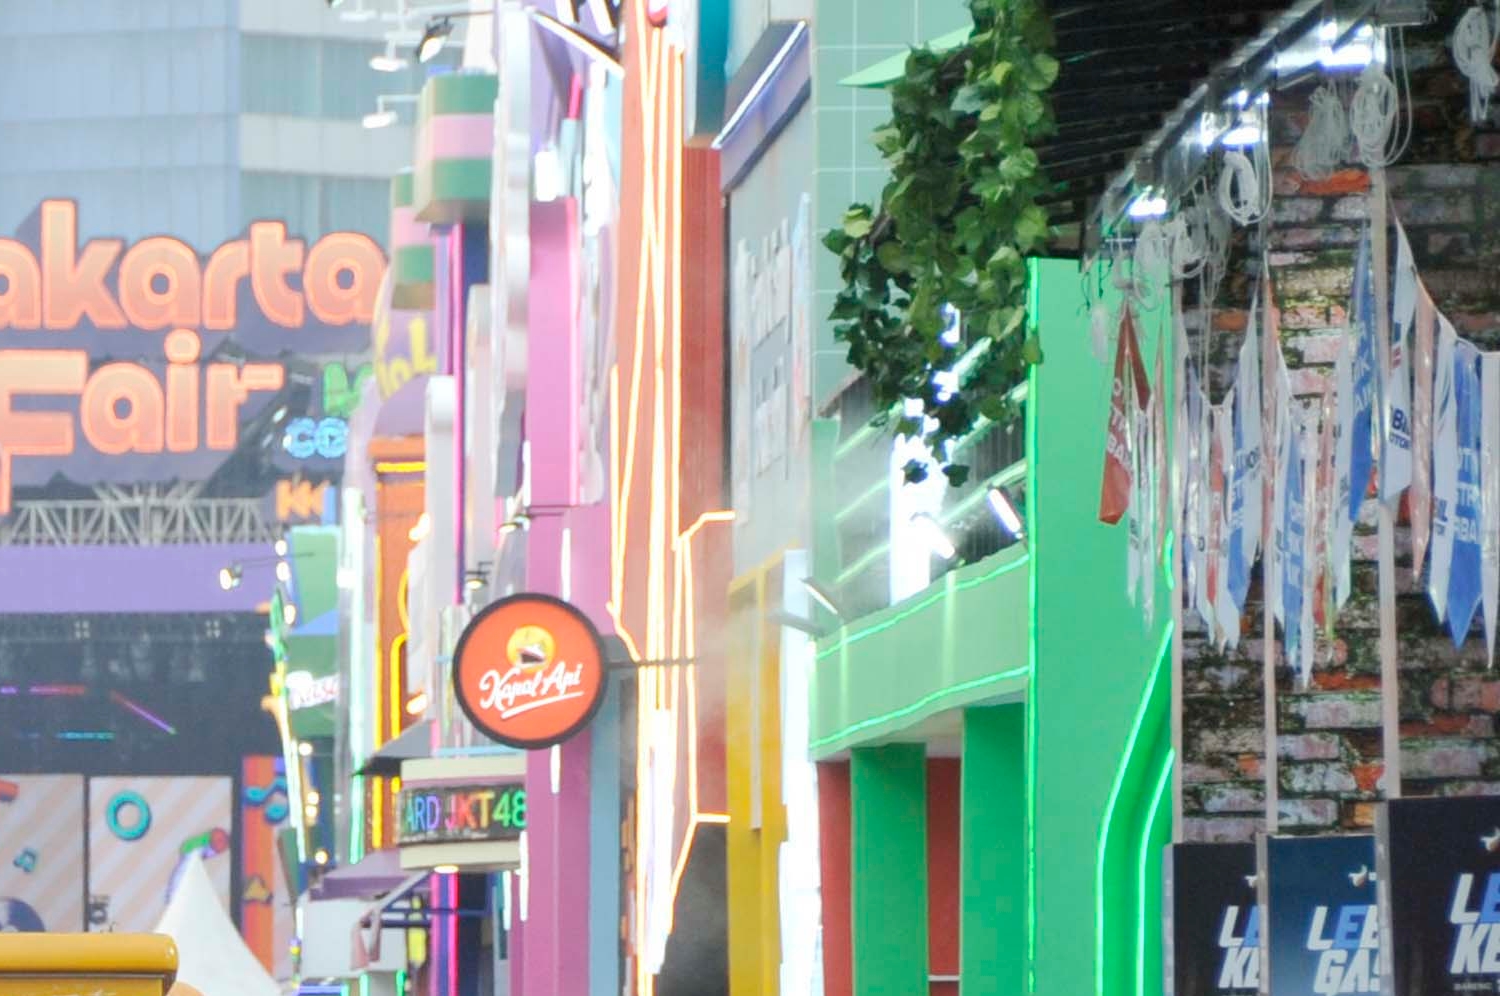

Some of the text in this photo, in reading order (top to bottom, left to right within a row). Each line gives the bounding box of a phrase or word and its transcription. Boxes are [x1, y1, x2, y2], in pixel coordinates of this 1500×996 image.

[478, 660, 583, 713] Kapal Api
[444, 787, 527, 832] JKT48
